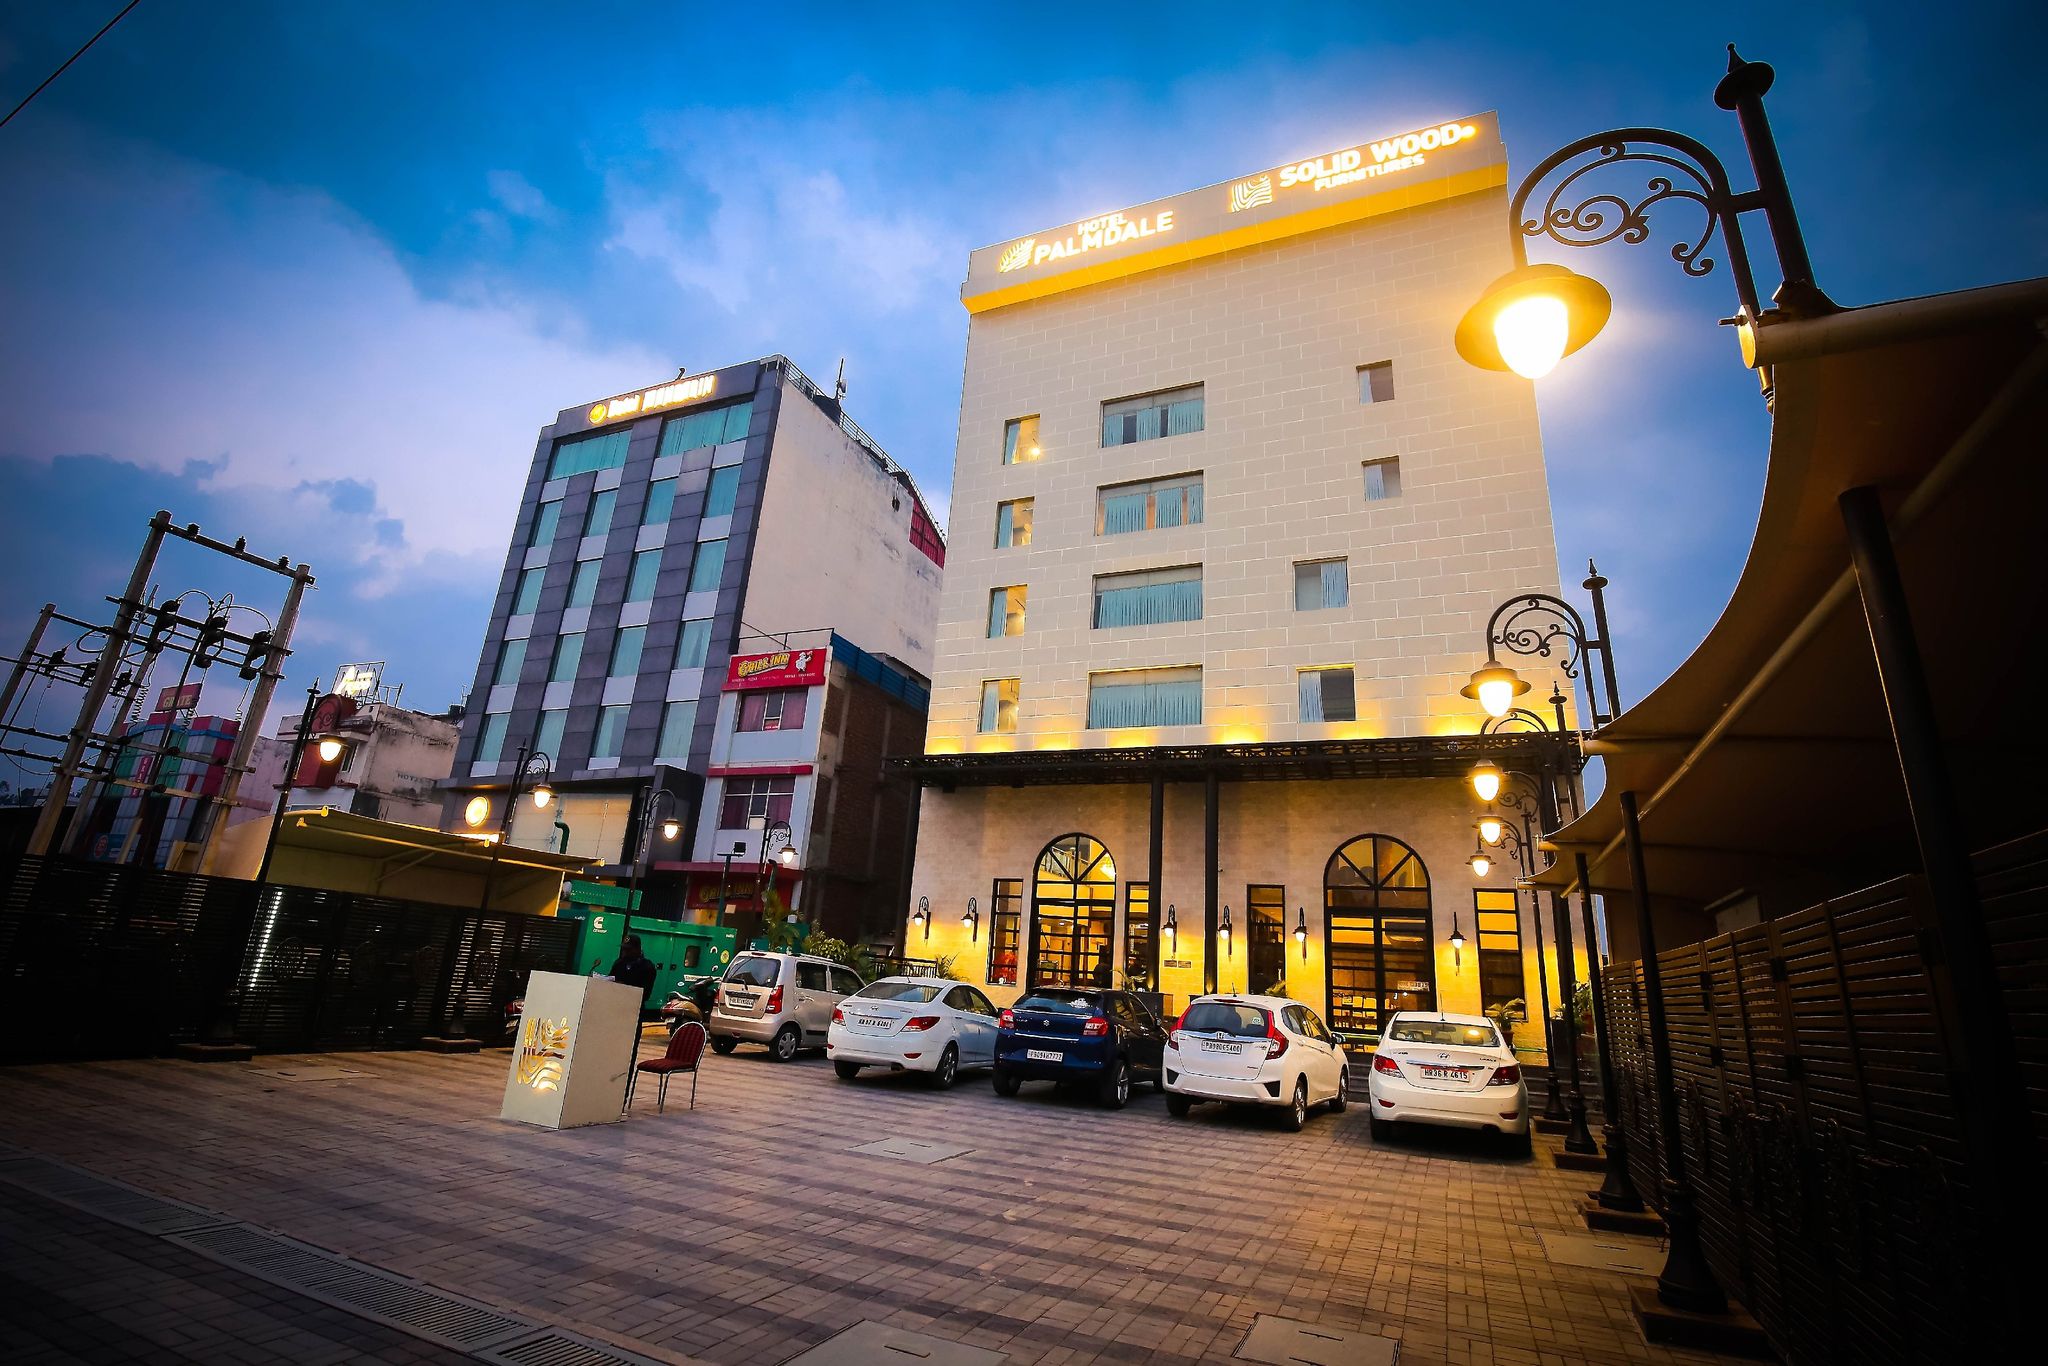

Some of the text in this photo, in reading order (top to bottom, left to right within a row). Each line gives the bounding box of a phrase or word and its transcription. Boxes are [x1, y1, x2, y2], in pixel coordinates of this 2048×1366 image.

[1280, 123, 1462, 188] SOLID WOOD
[1314, 153, 1426, 192] FURNITURES
[1033, 210, 1175, 266] PALMDALE
[1078, 213, 1127, 236] HOTEL
[770, 653, 791, 666] INN
